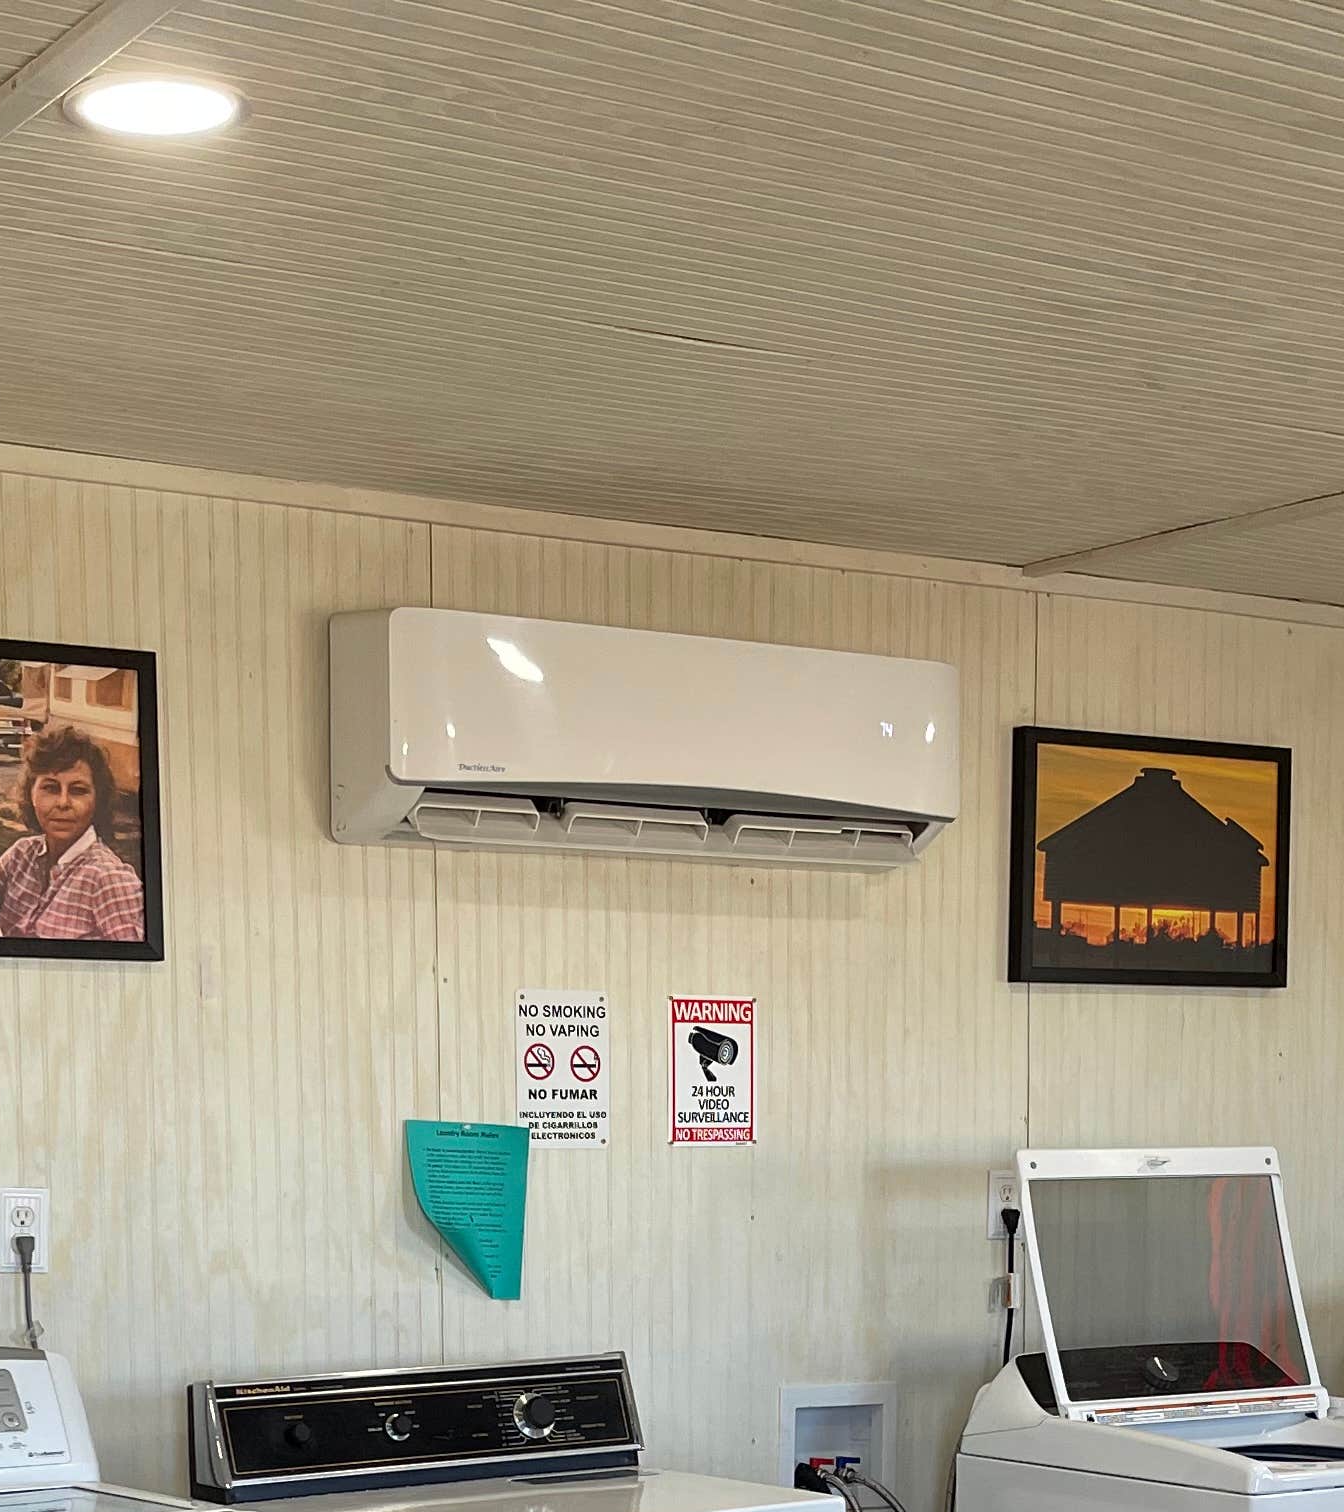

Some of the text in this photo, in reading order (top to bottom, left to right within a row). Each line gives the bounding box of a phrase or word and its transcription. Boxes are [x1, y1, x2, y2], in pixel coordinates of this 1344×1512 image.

[519, 1004, 606, 1019] NO SMOKING
[674, 1002, 752, 1022] WARNING
[526, 1024, 600, 1038] NO VAPING
[528, 1088, 598, 1100] NO FUMAR
[691, 1086, 735, 1098] 24 HOUR
[698, 1099, 730, 1110] VIDEO
[519, 1111, 607, 1119] INCLUYENDO EL USO
[677, 1111, 749, 1124] SURVEILLANCE
[528, 1121, 598, 1129] DE CIGARRILLOS
[675, 1128, 750, 1141] NO TRESPASSING
